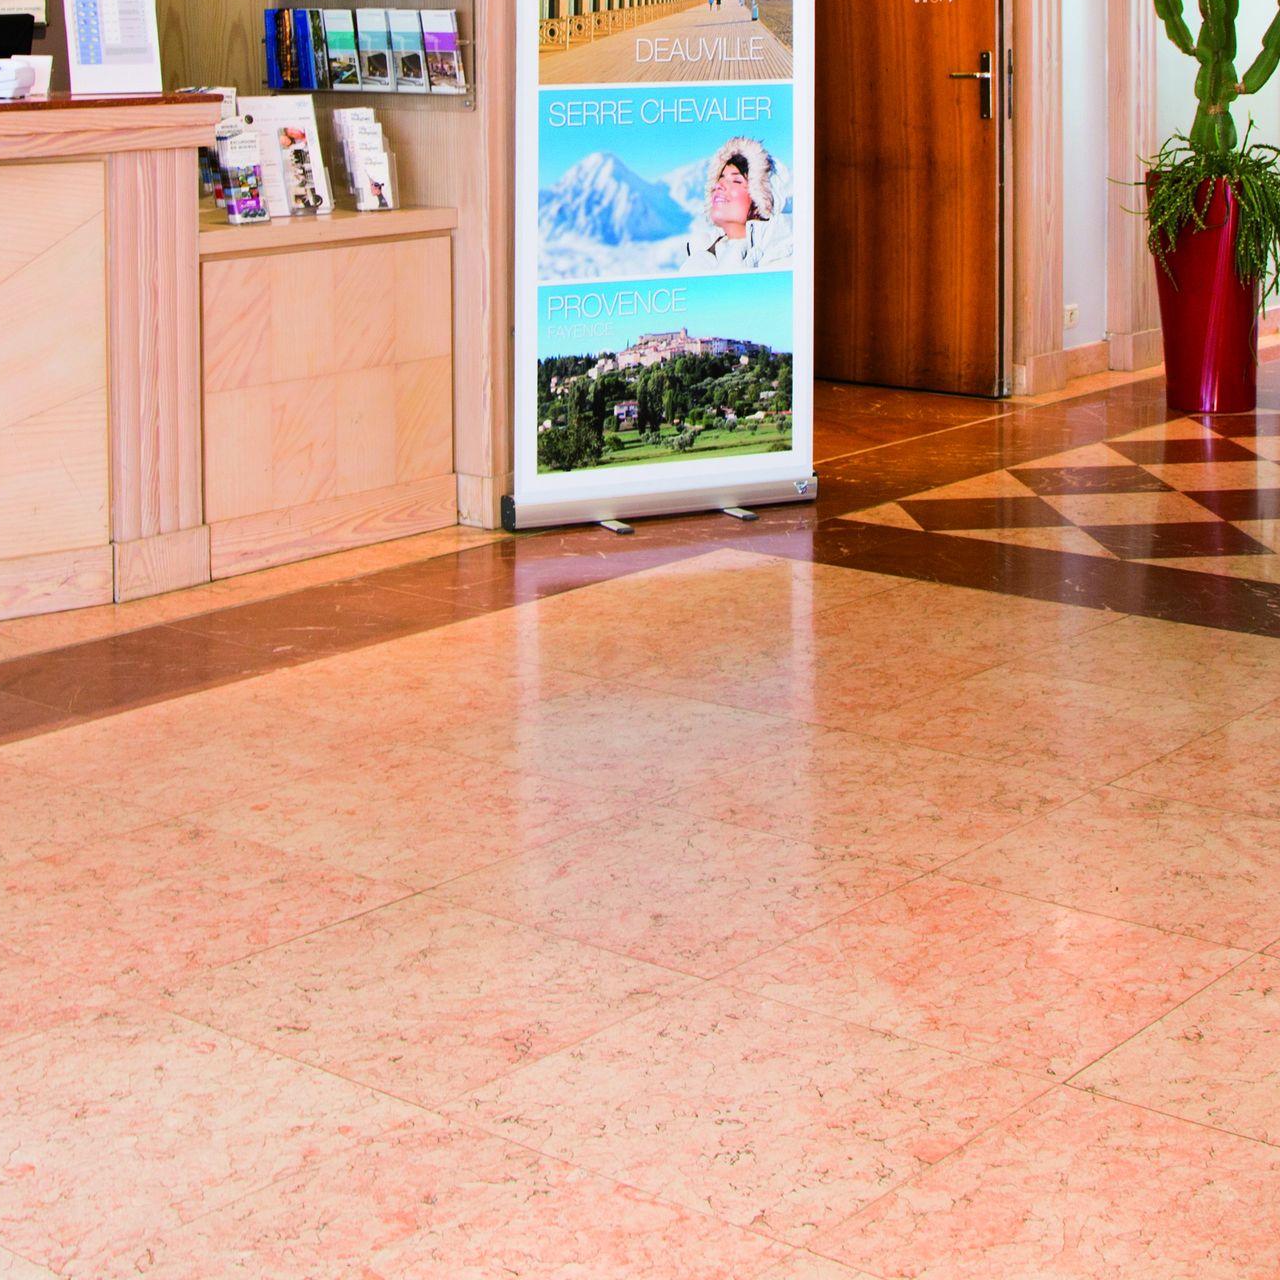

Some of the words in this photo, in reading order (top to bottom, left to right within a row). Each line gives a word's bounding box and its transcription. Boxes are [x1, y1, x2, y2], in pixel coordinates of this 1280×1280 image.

[635, 36, 765, 64] DEAUVILLE
[548, 99, 633, 128] SERRE
[639, 95, 772, 125] CHEVALIER
[547, 286, 688, 320] PROVENCE
[547, 322, 615, 338] FAYENCE
